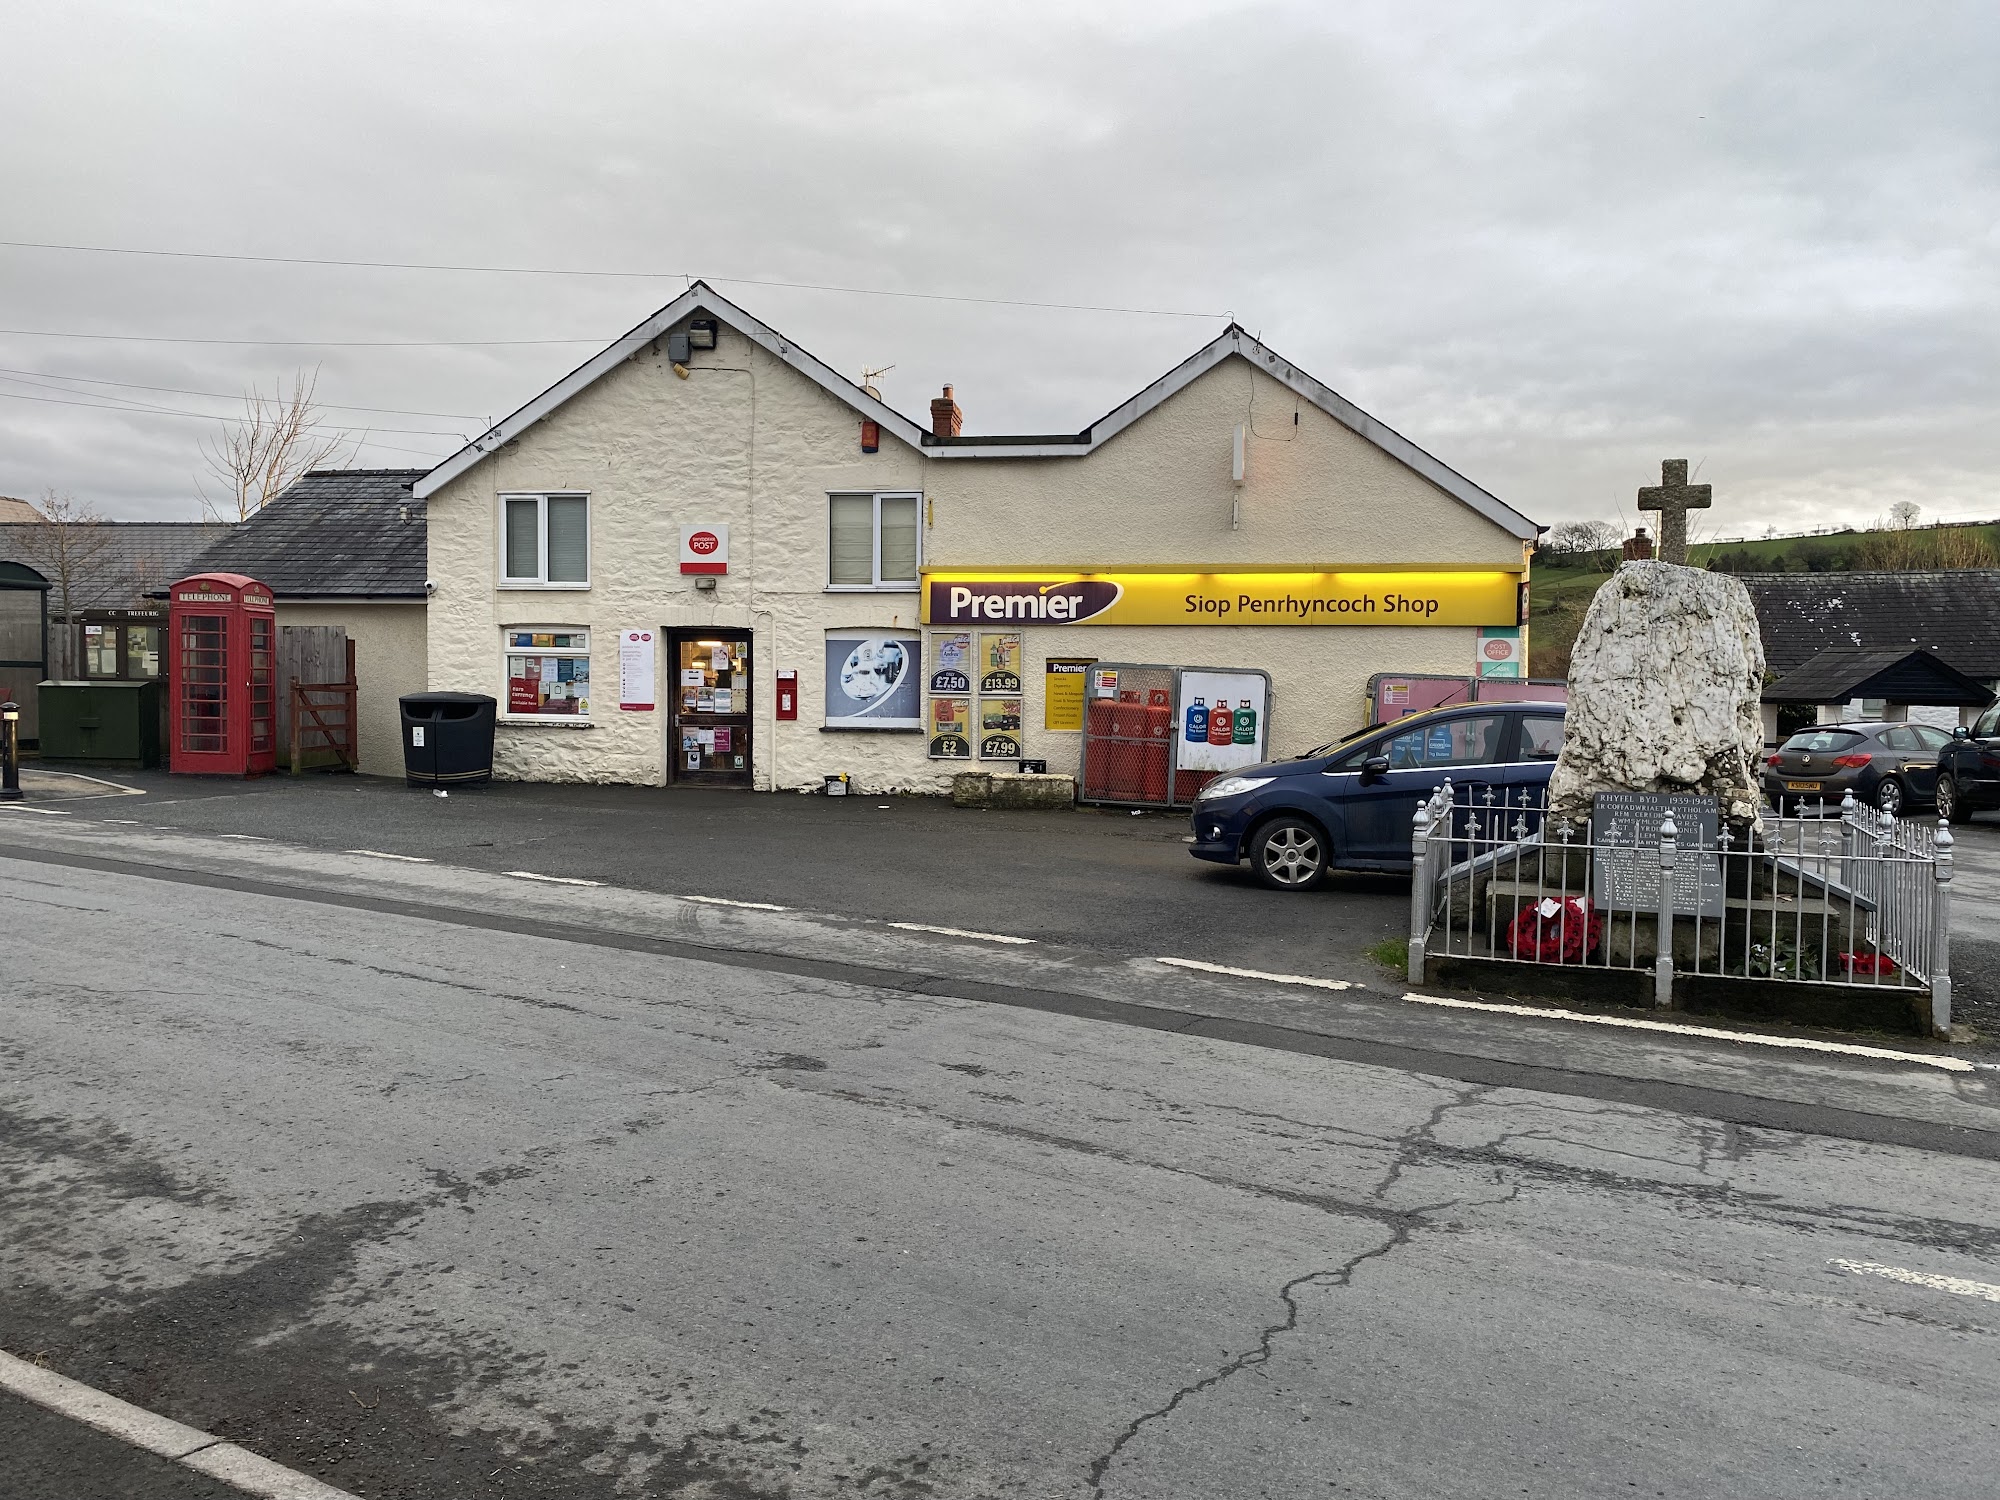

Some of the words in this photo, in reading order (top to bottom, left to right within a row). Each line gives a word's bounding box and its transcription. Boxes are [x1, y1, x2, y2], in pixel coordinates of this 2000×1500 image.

[950, 586, 1083, 618] Premier
[1185, 594, 1230, 617] Siop
[1238, 594, 1375, 617] Penrhyncoch
[1384, 594, 1438, 617] Shop
[1053, 664, 1087, 672] Premier
[936, 677, 965, 688] £7.50
[985, 678, 1018, 689] £13.99
[942, 741, 956, 752] £2
[986, 741, 1016, 754] £7.99
[1600, 794, 1634, 802] RHYFEL
[1640, 796, 1658, 804] BYD
[1670, 797, 1713, 806] 1939-1945
